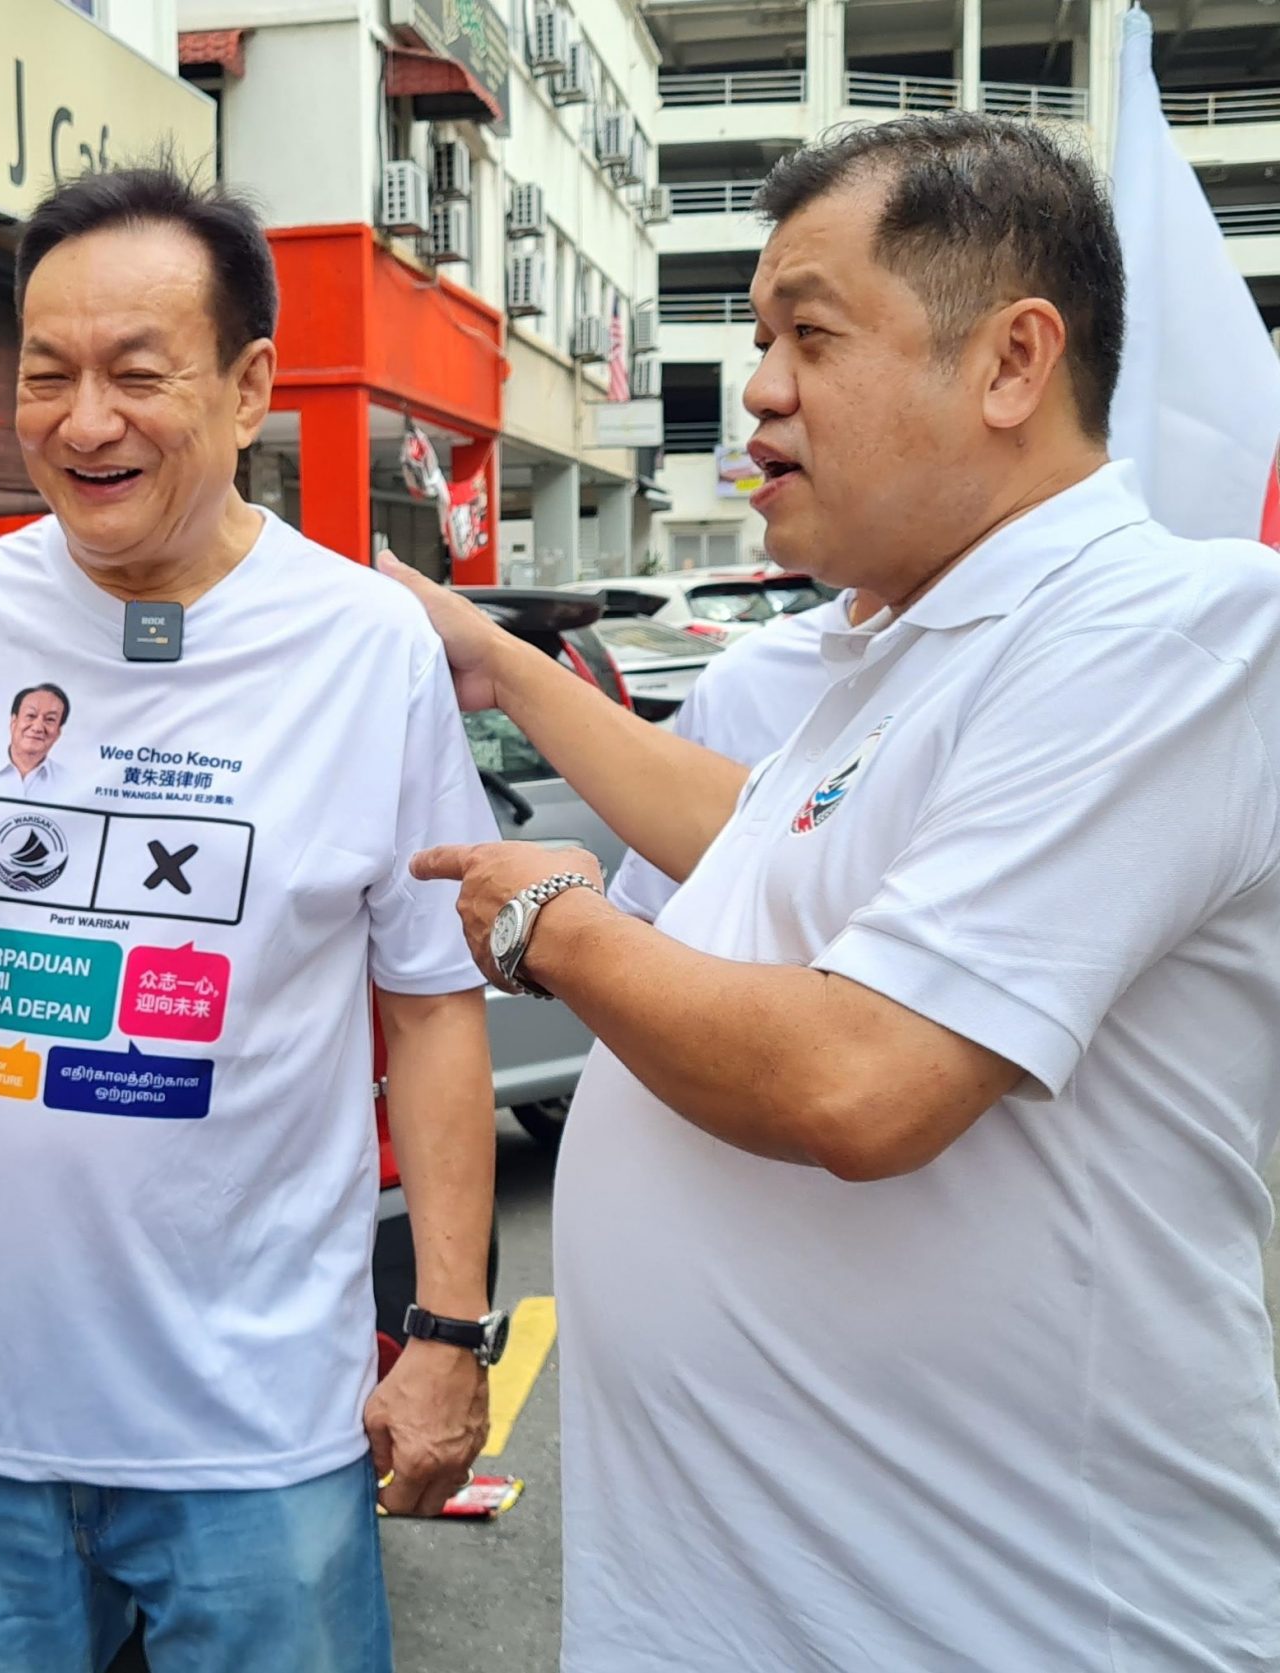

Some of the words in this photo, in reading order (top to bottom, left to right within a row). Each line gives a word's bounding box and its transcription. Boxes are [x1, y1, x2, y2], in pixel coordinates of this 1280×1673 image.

[100, 745, 134, 761] Wee
[137, 747, 183, 765] Choo
[186, 751, 243, 773] Keong
[122, 789, 163, 801] WANGSA
[13, 815, 53, 830] WARISAN
[50, 913, 75, 926] Parti
[78, 916, 130, 931] WARISAN
[17, 997, 91, 1025] DEPAN
[135, 992, 211, 1018] 迎向未来
